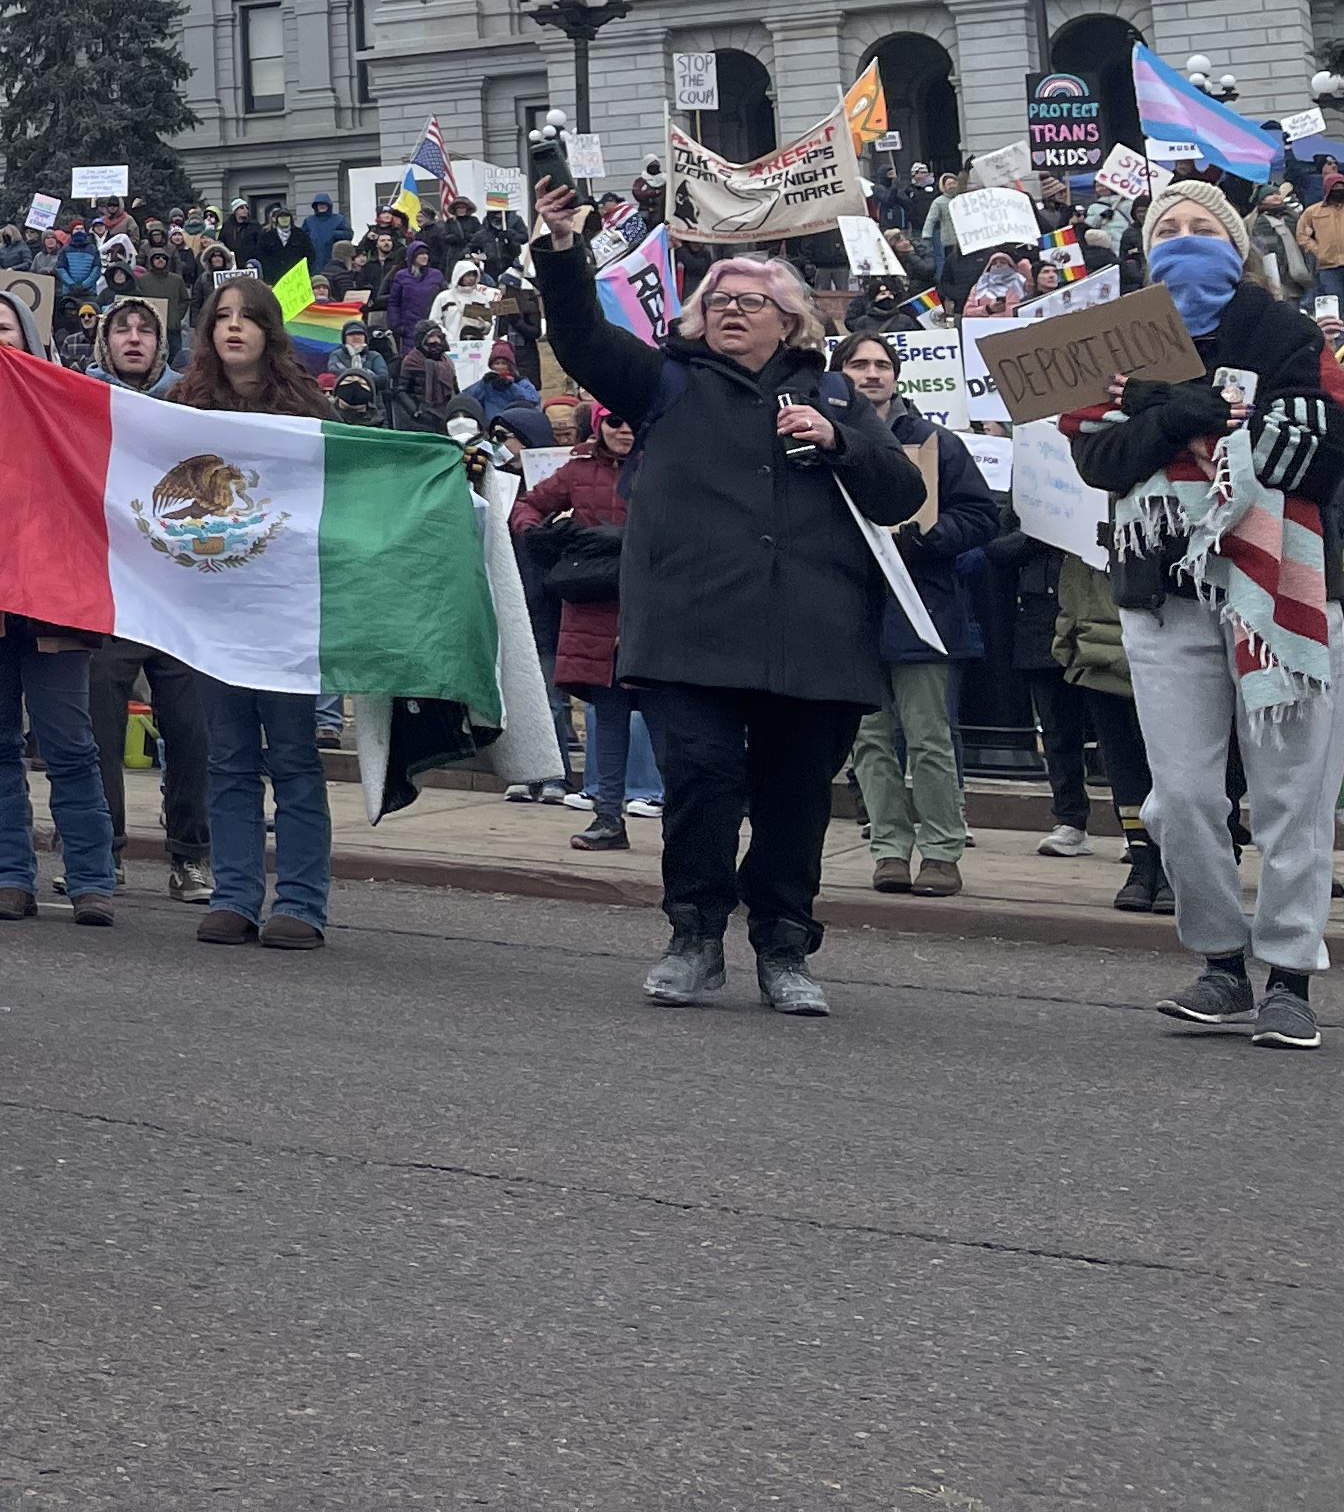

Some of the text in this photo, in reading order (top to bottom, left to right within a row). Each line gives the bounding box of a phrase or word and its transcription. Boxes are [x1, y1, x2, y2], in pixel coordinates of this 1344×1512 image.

[678, 54, 713, 73] STOP
[680, 74, 704, 87] THE
[1029, 102, 1099, 118] PROTECT
[1030, 123, 1099, 142] TRANS
[784, 164, 838, 188] NIGHT
[1119, 156, 1158, 177] STOP
[784, 181, 845, 205] MARE
[896, 345, 958, 362] SPECT
[998, 313, 1187, 403] DEPORT ELON
[895, 377, 956, 393] DNESS
